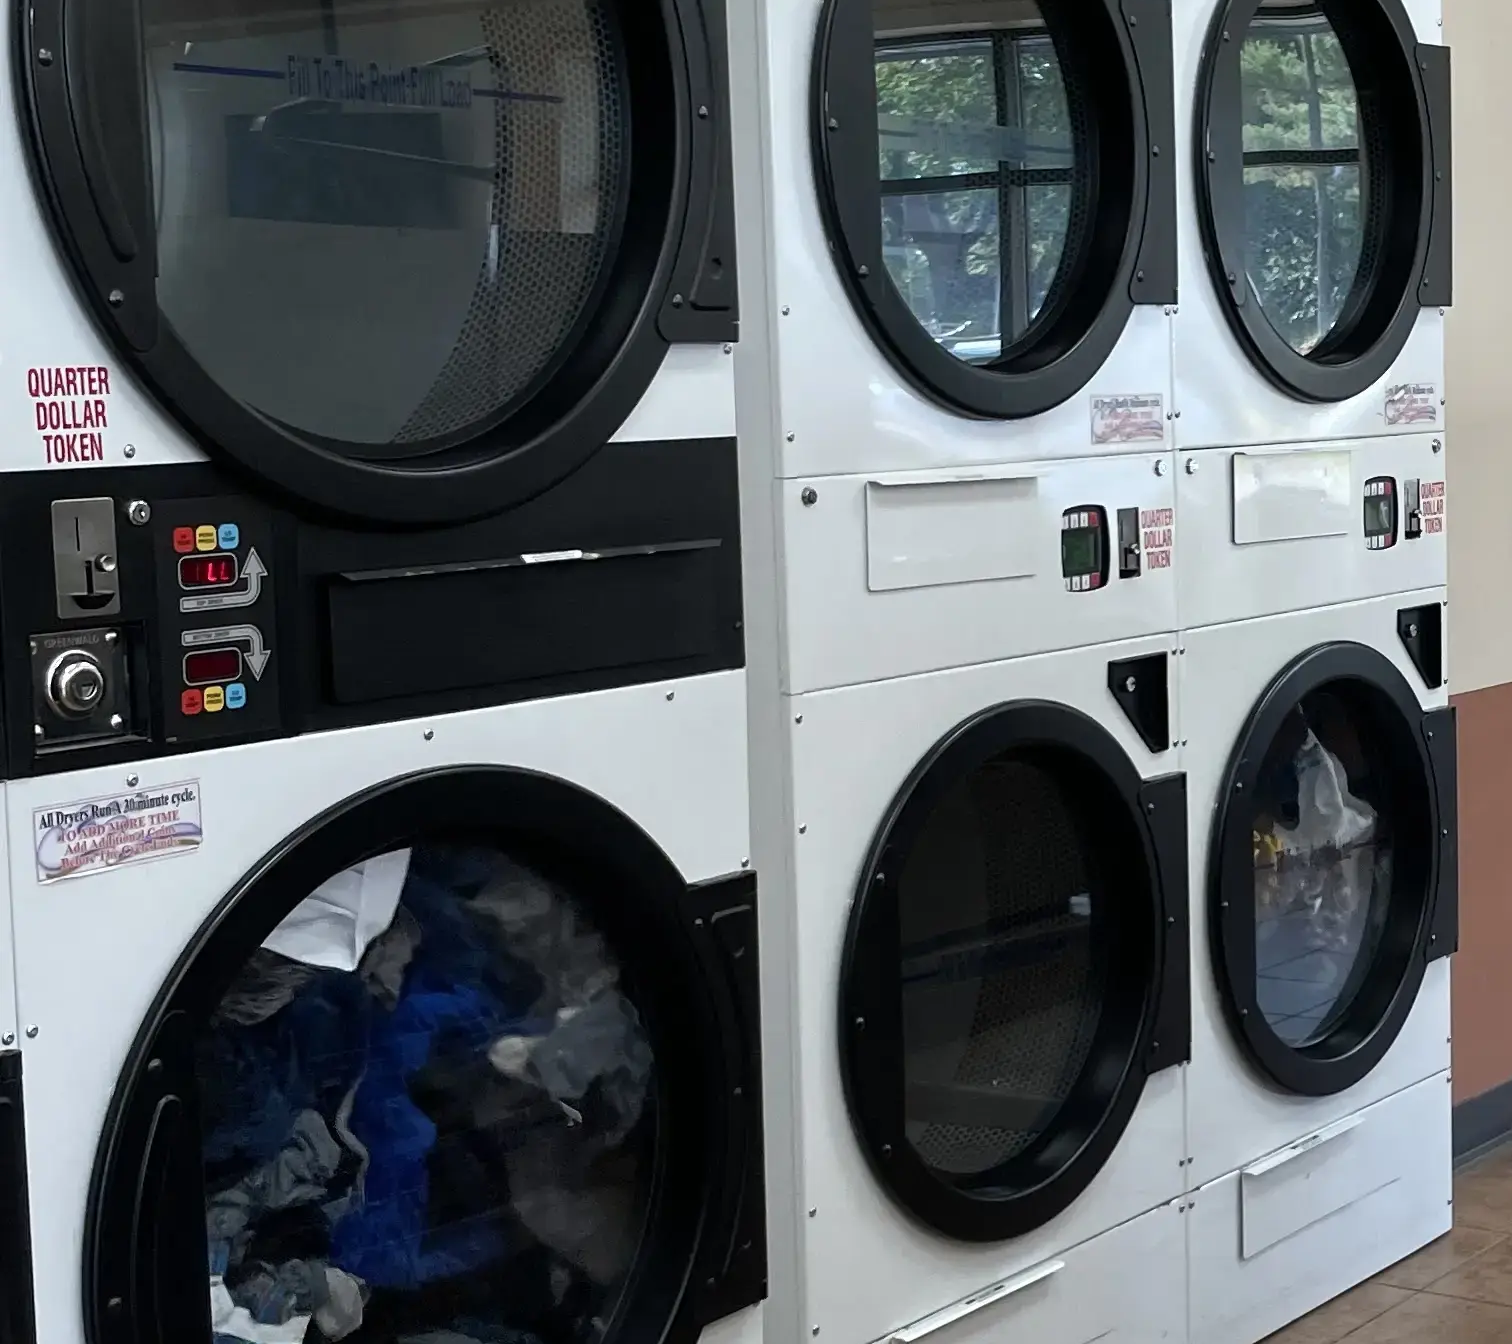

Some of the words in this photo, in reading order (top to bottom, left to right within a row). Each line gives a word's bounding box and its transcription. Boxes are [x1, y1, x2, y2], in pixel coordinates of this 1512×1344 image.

[28, 367, 110, 398] QUARTER
[36, 399, 108, 430] DOLLAR
[42, 432, 104, 463] TOKEN
[1141, 508, 1174, 529] QUARTER
[1144, 529, 1172, 550] DOLLAR
[1146, 550, 1171, 570] TOKEN
[39, 812, 54, 830] All
[56, 808, 89, 828] Dryers
[91, 803, 112, 819] Run
[171, 788, 196, 807] cycle.
[148, 810, 181, 826] TIME
[66, 840, 87, 856] Add
